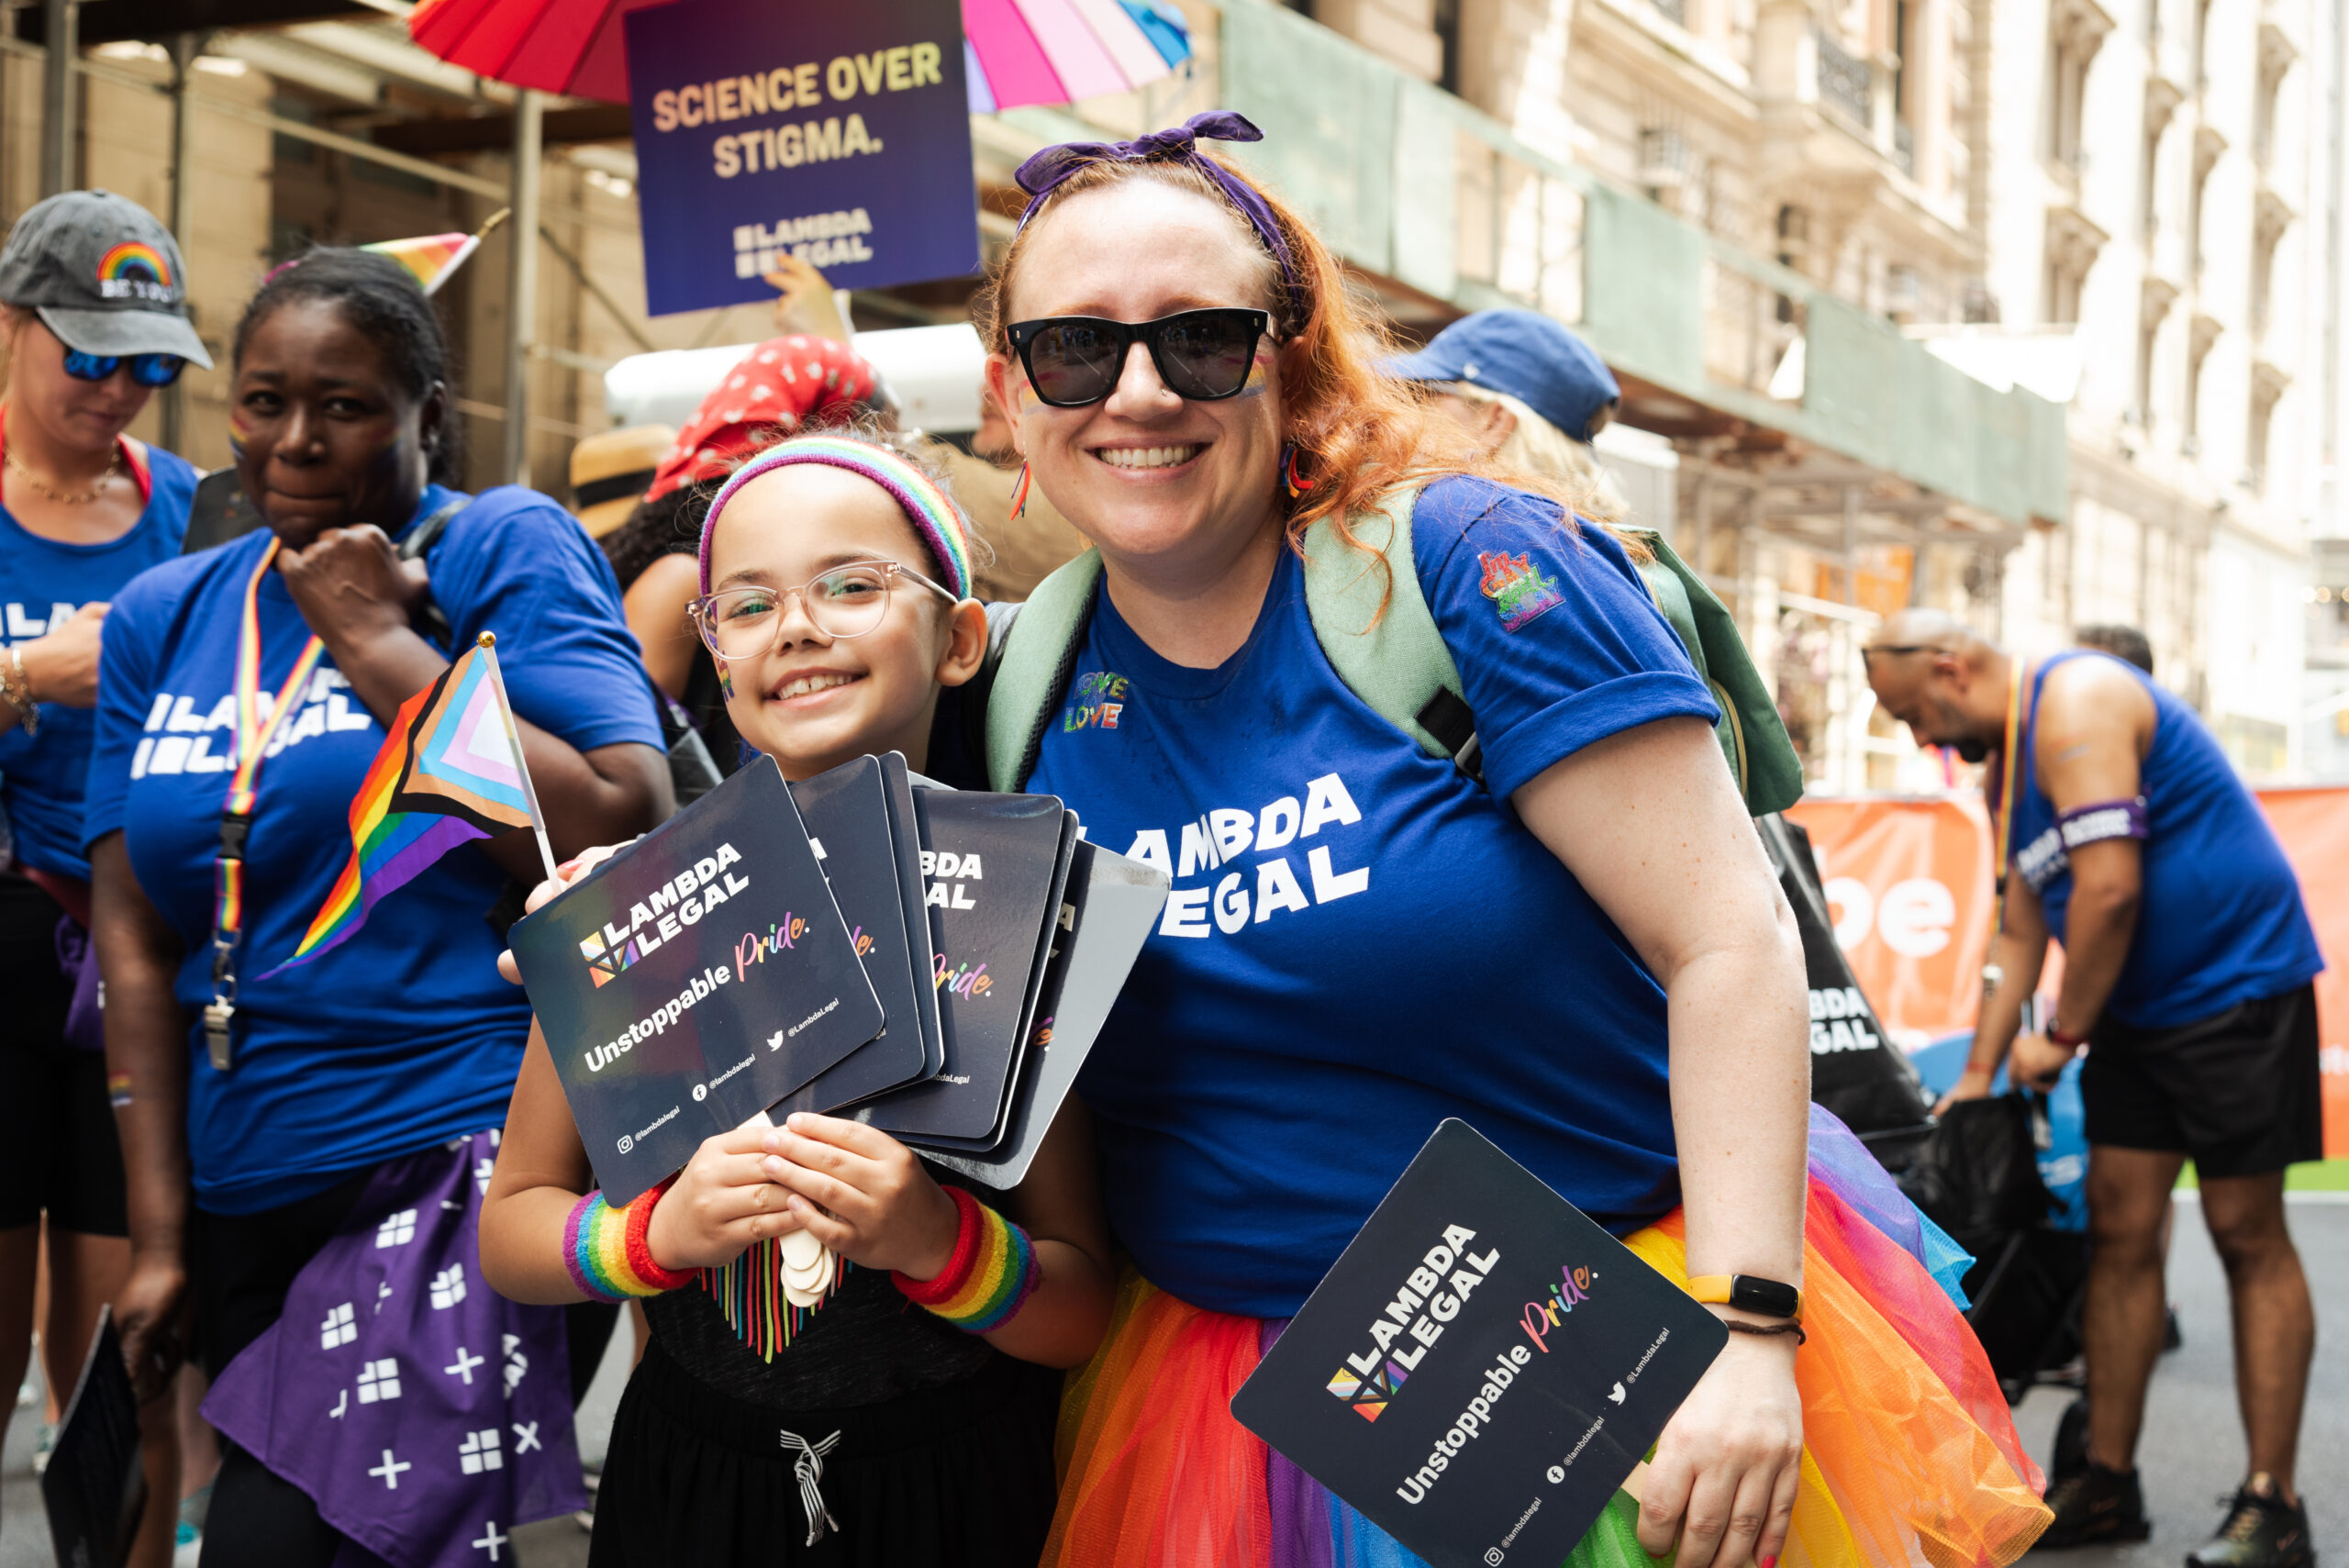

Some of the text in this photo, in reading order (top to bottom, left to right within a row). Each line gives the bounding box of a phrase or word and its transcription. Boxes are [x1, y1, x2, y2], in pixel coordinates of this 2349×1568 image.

[652, 41, 942, 132] SCIENCE OVER
[713, 113, 884, 179] STIGMA.
[755, 207, 873, 248] LAMBDA
[101, 279, 132, 297] BE
[1064, 703, 1123, 732] LOVE
[1079, 773, 1362, 878] AMBDA
[603, 843, 741, 947] LAMBDA
[636, 873, 749, 957] LEGAL
[1158, 845, 1369, 938] EGAL
[584, 912, 809, 1072] Unstoppable Pride.
[788, 997, 839, 1037] @LambdaLegal
[709, 1053, 756, 1089] @lambdalegal
[635, 1105, 680, 1141] @lambdalegal
[1347, 1223, 1477, 1376] LAMBDA
[1392, 1247, 1500, 1372] LEGAL
[1396, 1264, 1598, 1506] Unstoppable Pride.
[1627, 1327, 1670, 1384] @LambdaLegal
[1564, 1416, 1605, 1466] @lambdalegal
[1501, 1496, 1542, 1549] @lambdalegal
